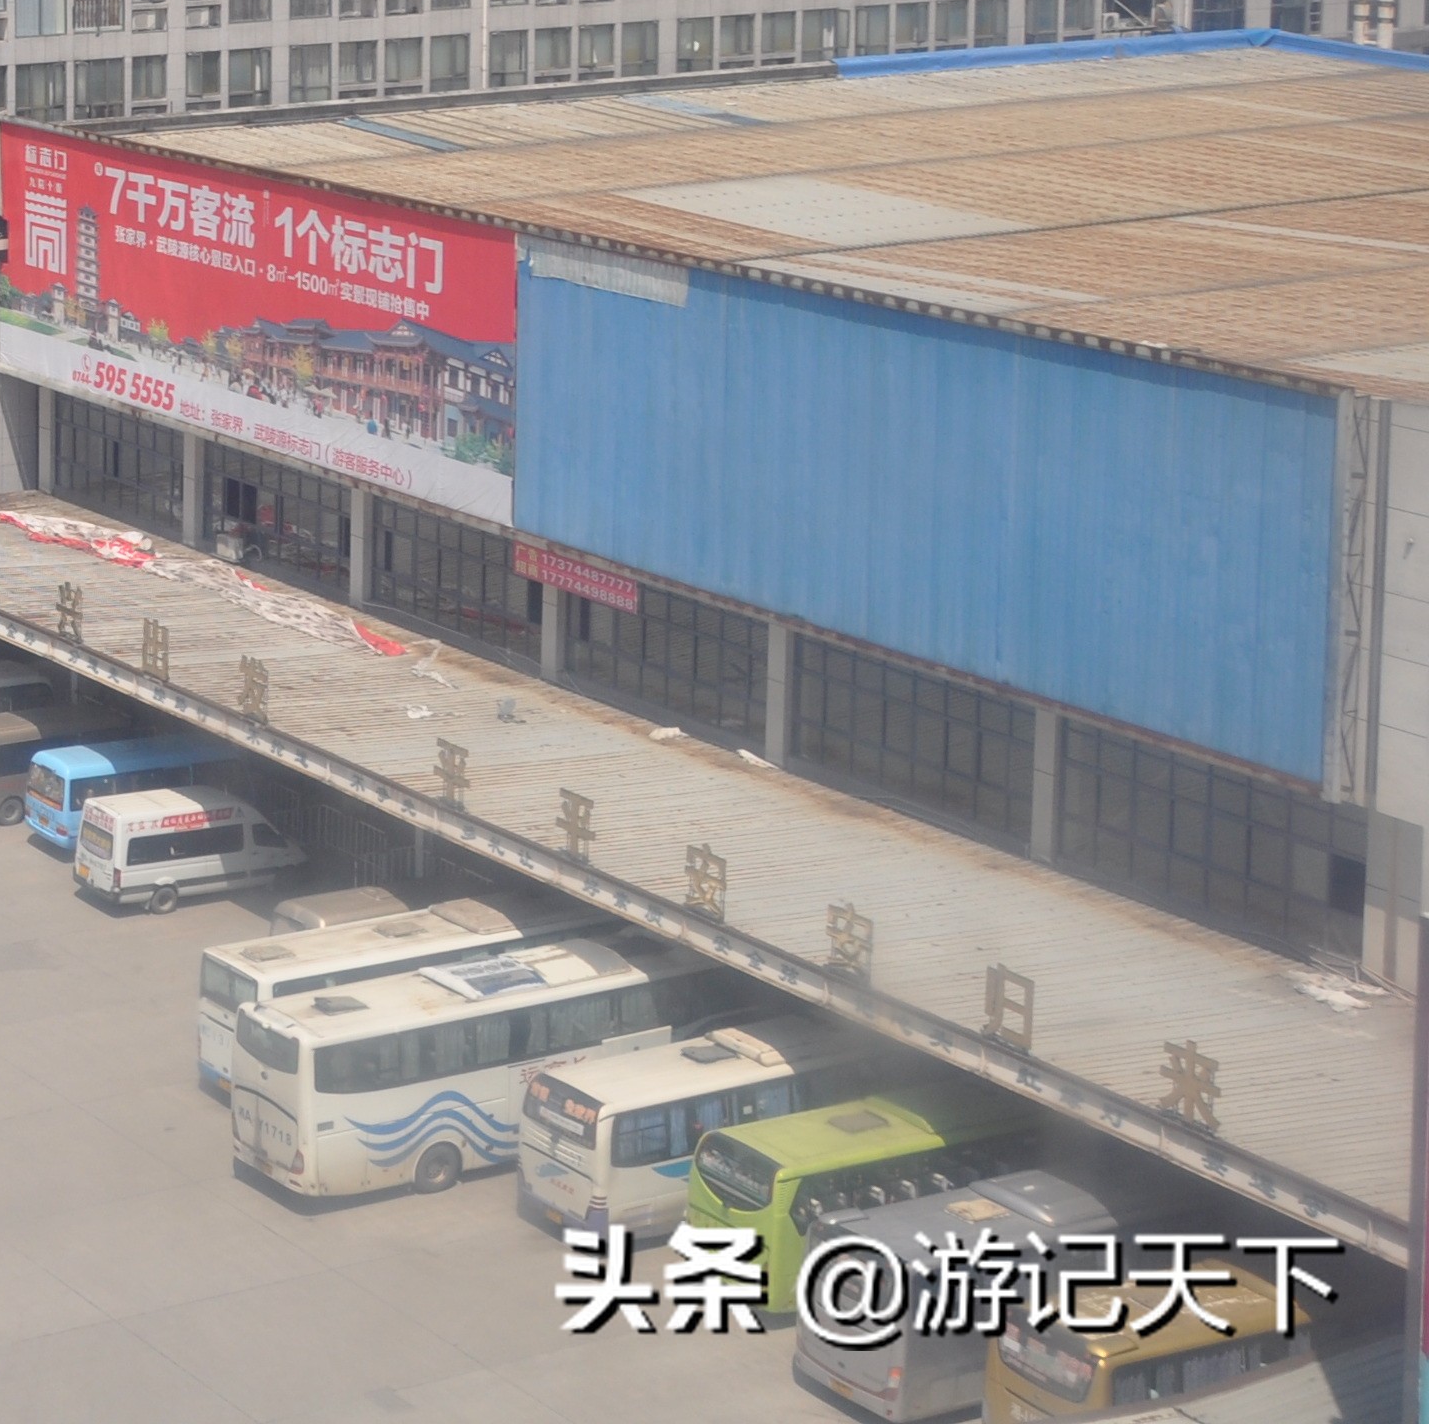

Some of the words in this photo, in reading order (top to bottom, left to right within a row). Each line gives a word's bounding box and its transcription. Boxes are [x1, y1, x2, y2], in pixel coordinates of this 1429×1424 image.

[104, 166, 256, 249] 7千万客流
[274, 206, 444, 295] 1个标志门
[542, 553, 633, 593] 17374487777
[542, 569, 634, 610] 17774498888
